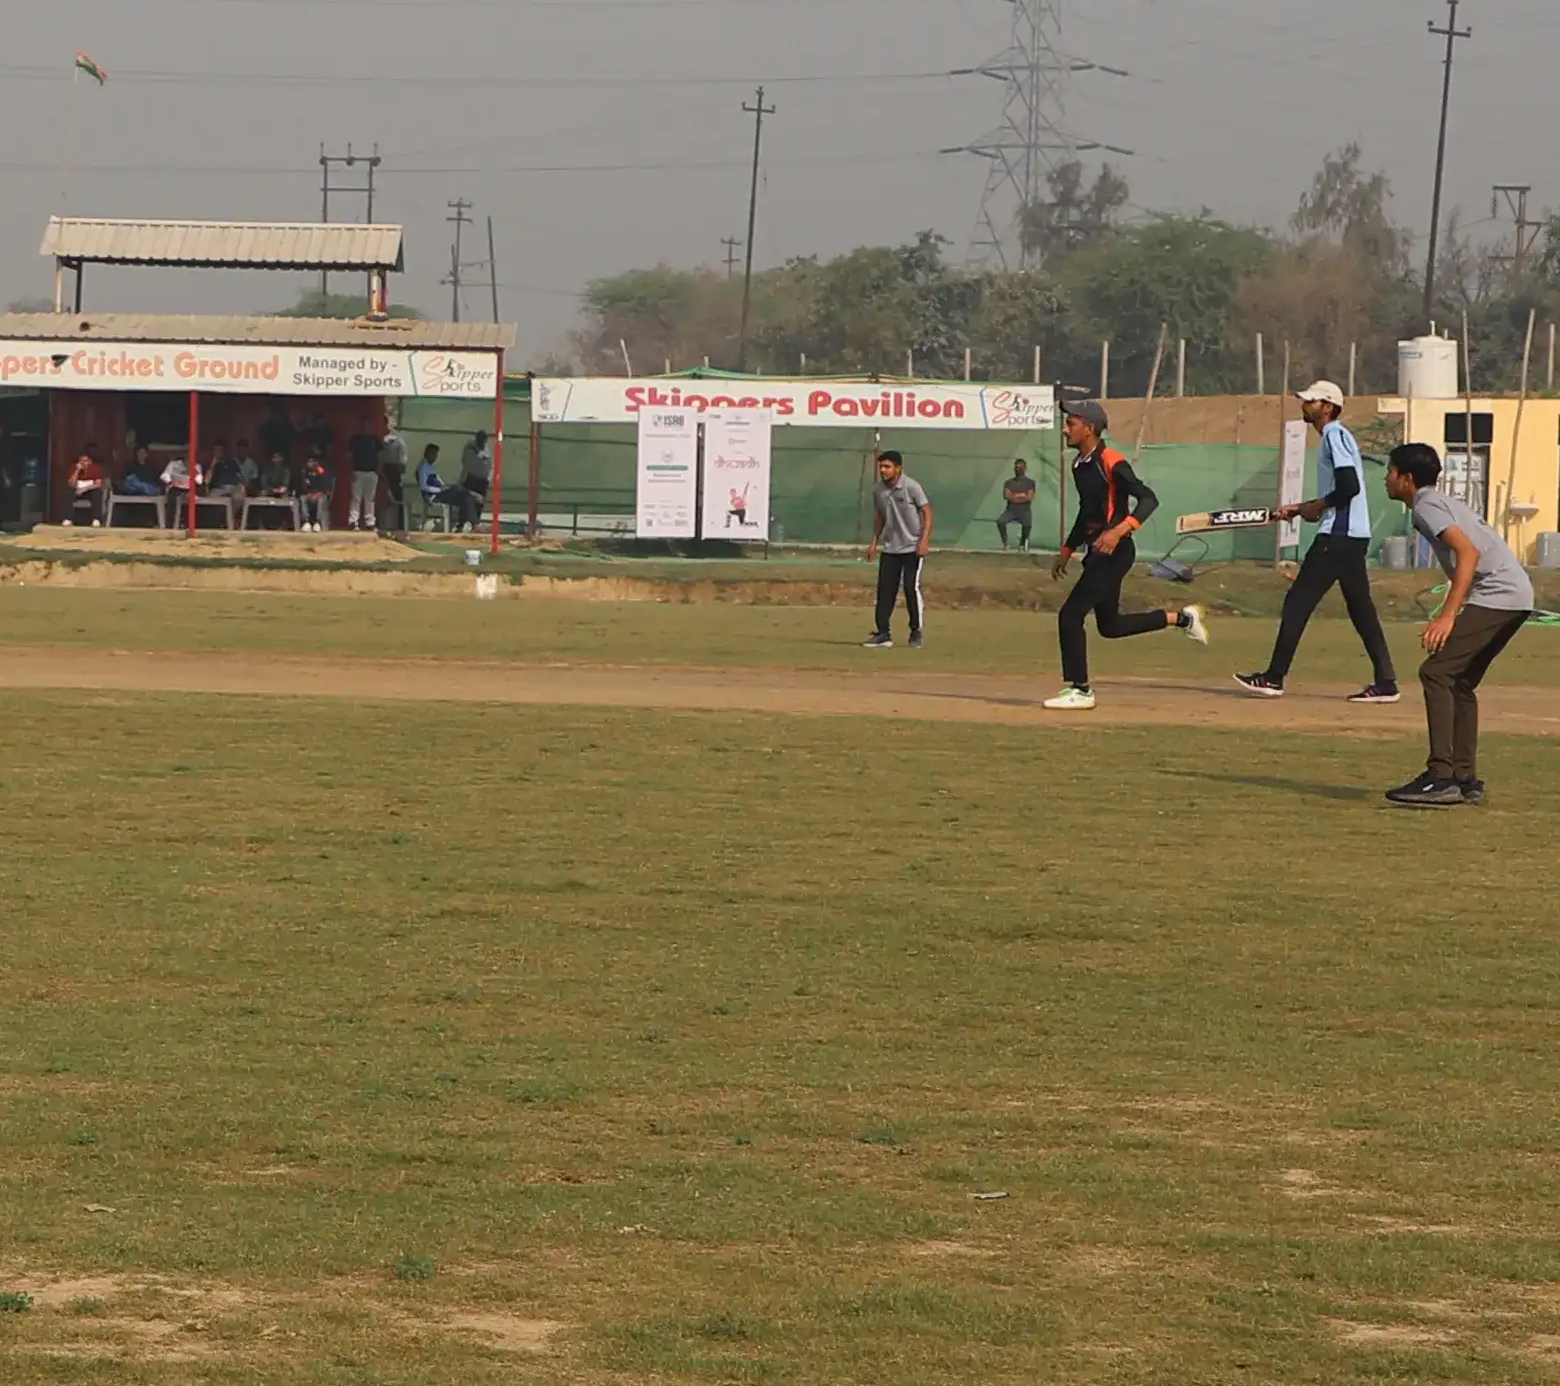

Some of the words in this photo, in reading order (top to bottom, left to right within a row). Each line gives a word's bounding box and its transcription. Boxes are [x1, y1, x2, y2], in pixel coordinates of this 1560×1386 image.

[72, 350, 164, 377] Cricket
[174, 352, 279, 381] Ground
[299, 356, 366, 371] Managed
[370, 357, 387, 372] by
[293, 373, 349, 388] Skipper
[353, 375, 401, 389] Sports
[808, 390, 964, 419] Pavilion
[1214, 510, 1265, 524] MRF
